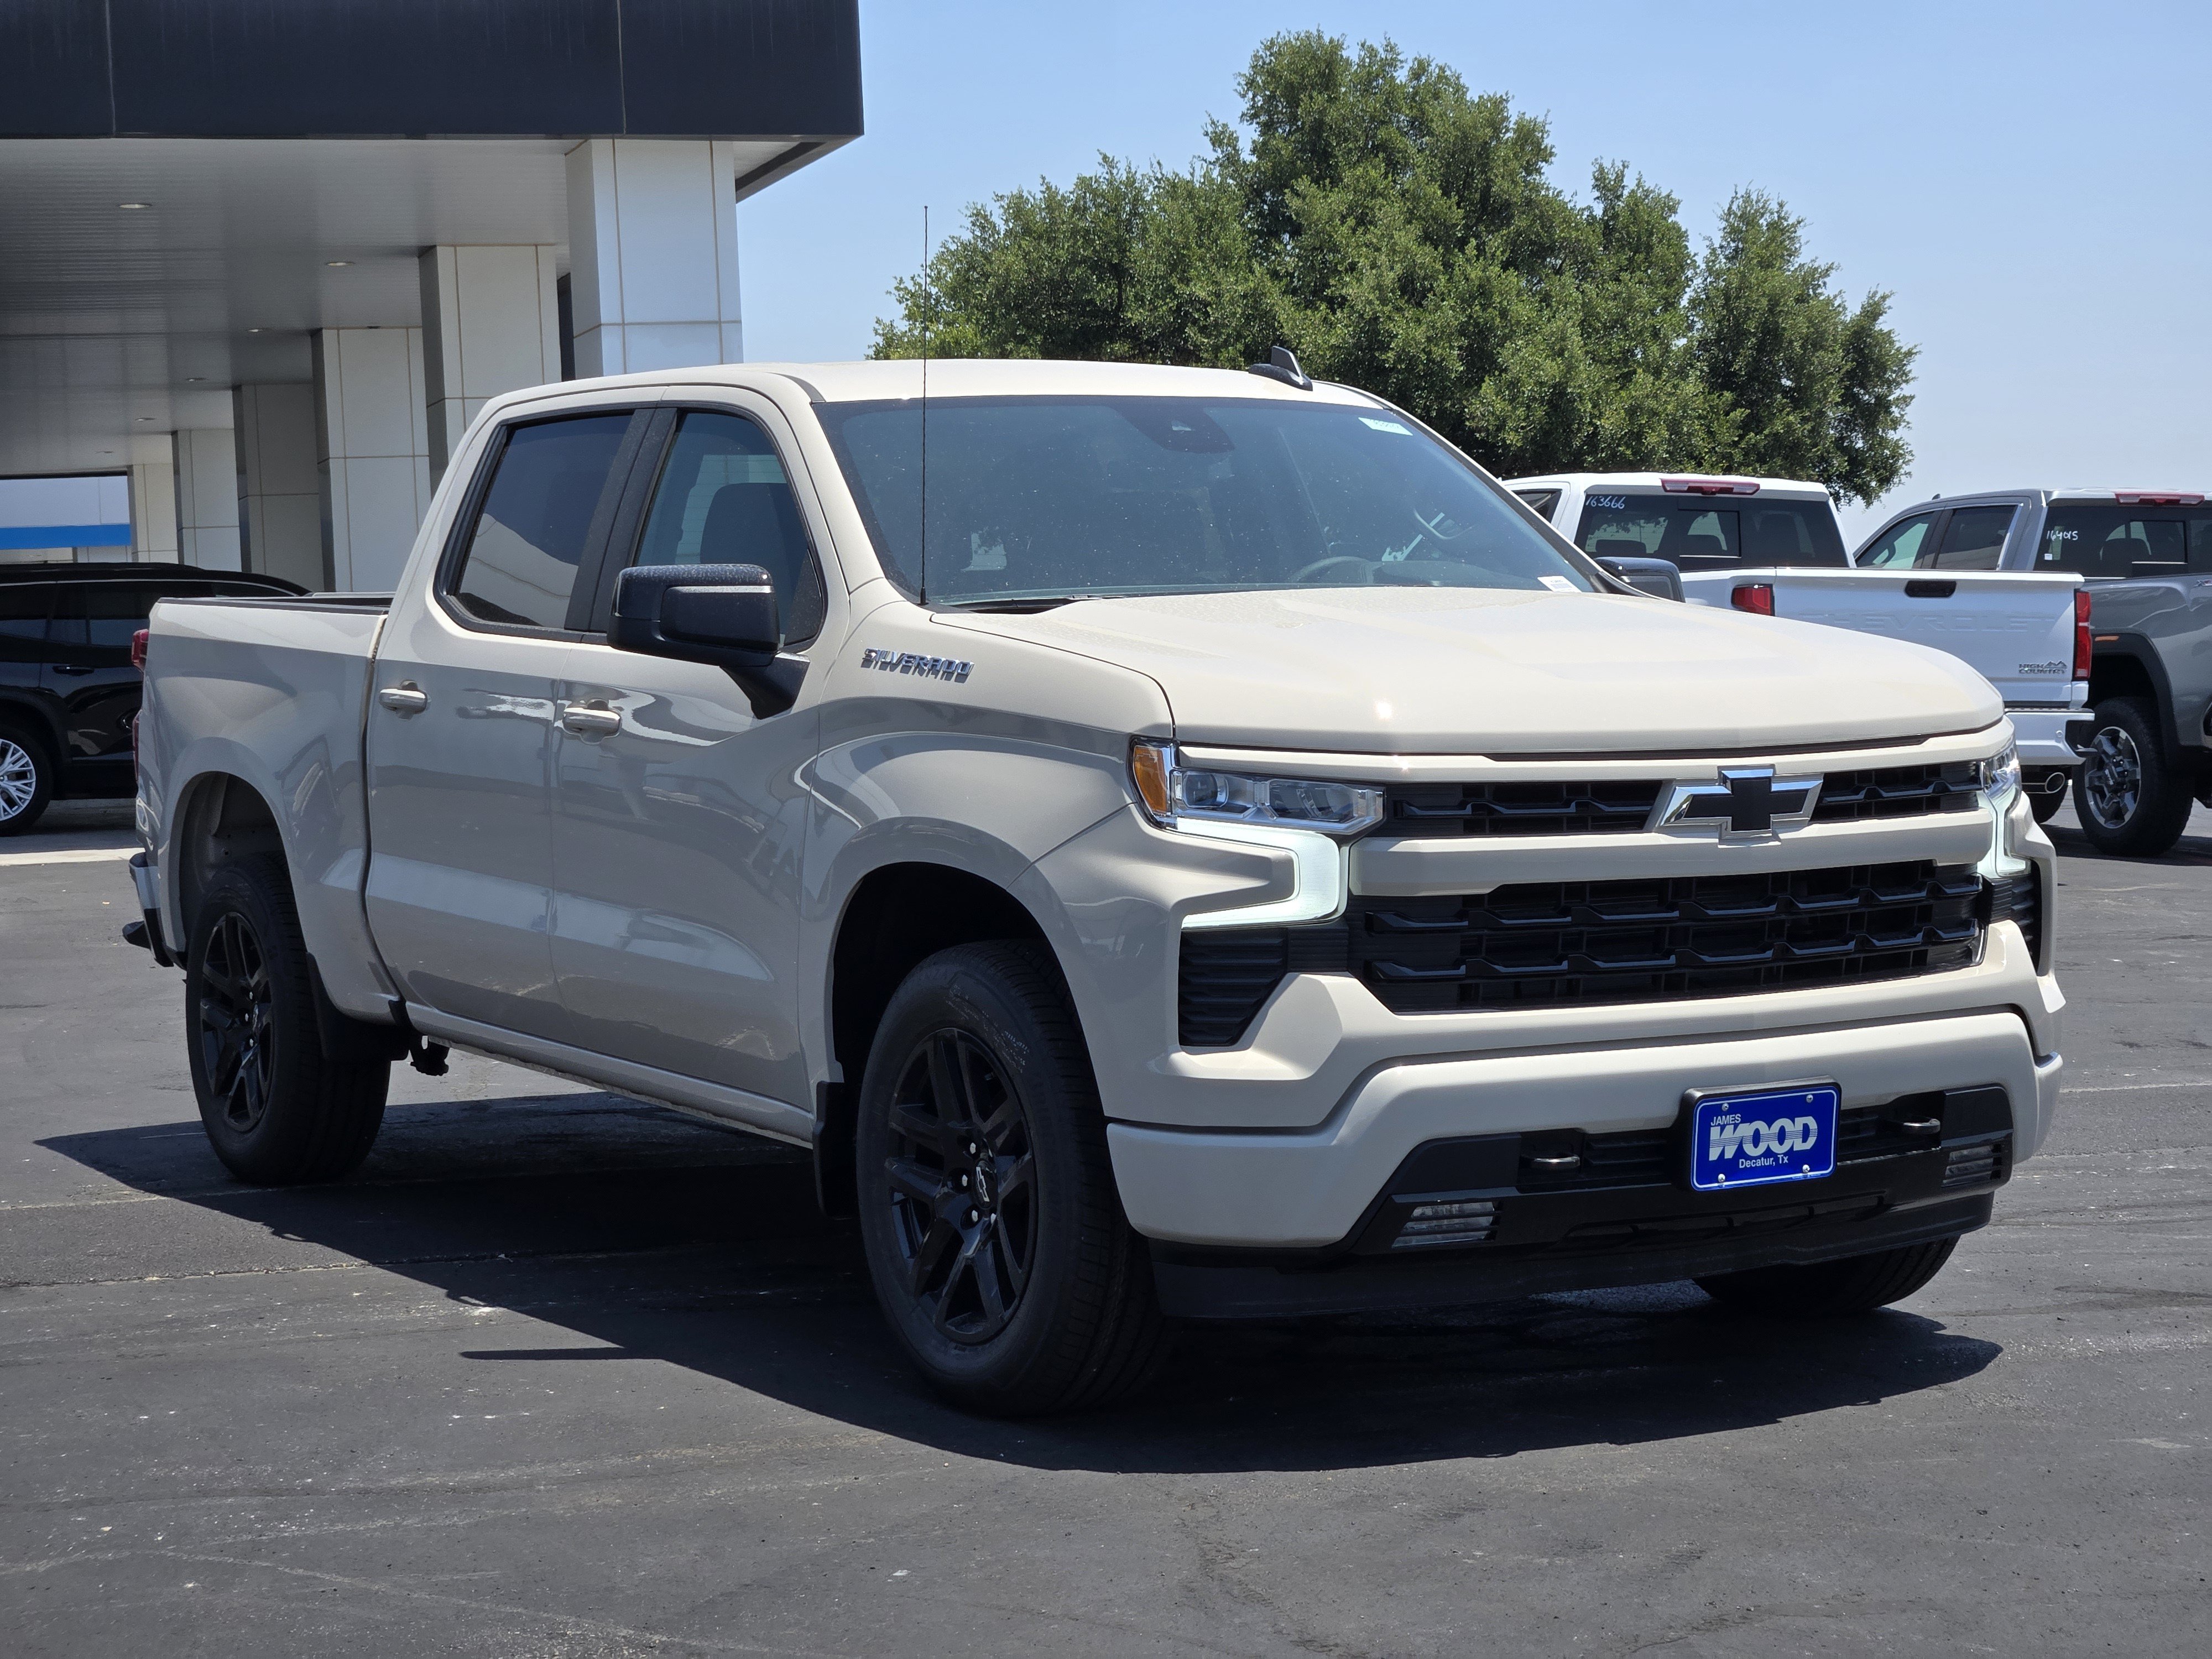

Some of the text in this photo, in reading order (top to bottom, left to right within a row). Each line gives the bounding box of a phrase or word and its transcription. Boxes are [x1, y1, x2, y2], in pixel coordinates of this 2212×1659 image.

[1585, 495, 1626, 509] 163666
[2047, 530, 2078, 541] 164015
[862, 648, 974, 676] SILVERADO
[1710, 1114, 1741, 1126] JAMES
[1709, 1116, 1818, 1161] WOOD
[1739, 1154, 1789, 1168] Decatur, Tx
